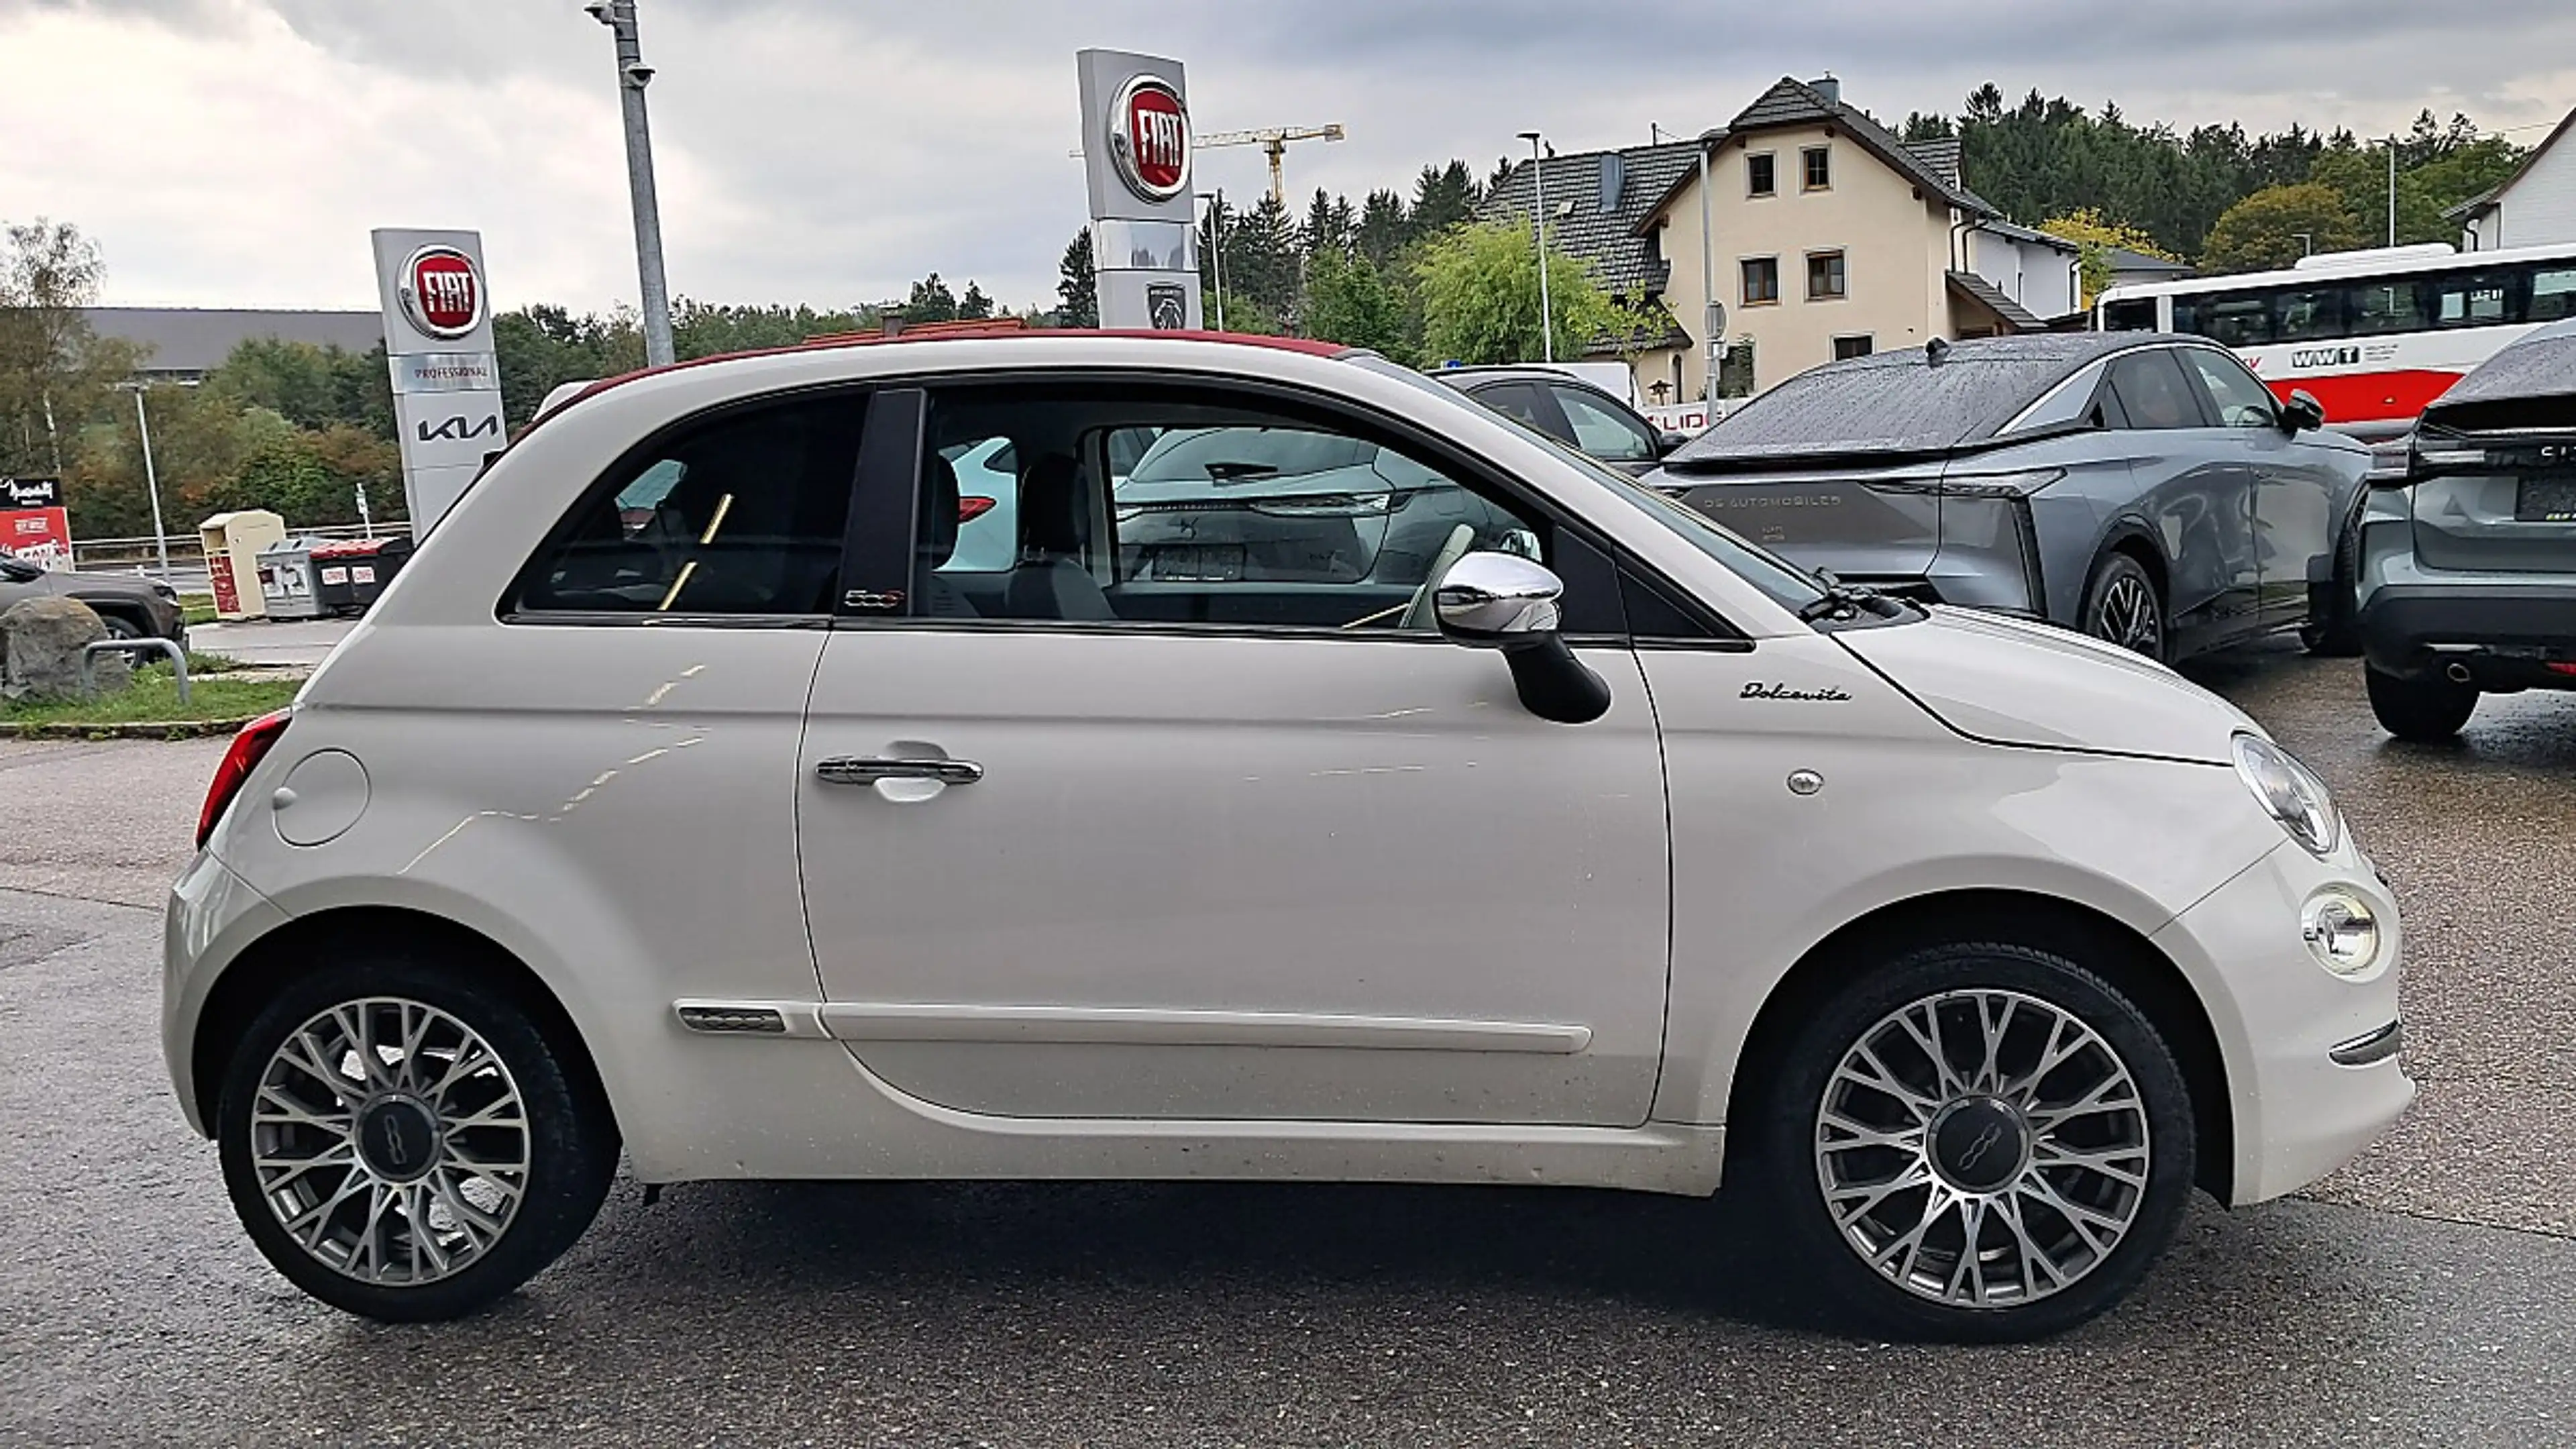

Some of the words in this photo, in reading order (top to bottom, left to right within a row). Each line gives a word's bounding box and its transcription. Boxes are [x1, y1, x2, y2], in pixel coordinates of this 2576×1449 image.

[1138, 109, 1181, 167] FIAT
[422, 272, 471, 313] FIAT
[2292, 345, 2359, 368] WWT
[413, 366, 488, 380] PROFESSIONAL
[1730, 496, 1841, 508] AUTOMOBILES
